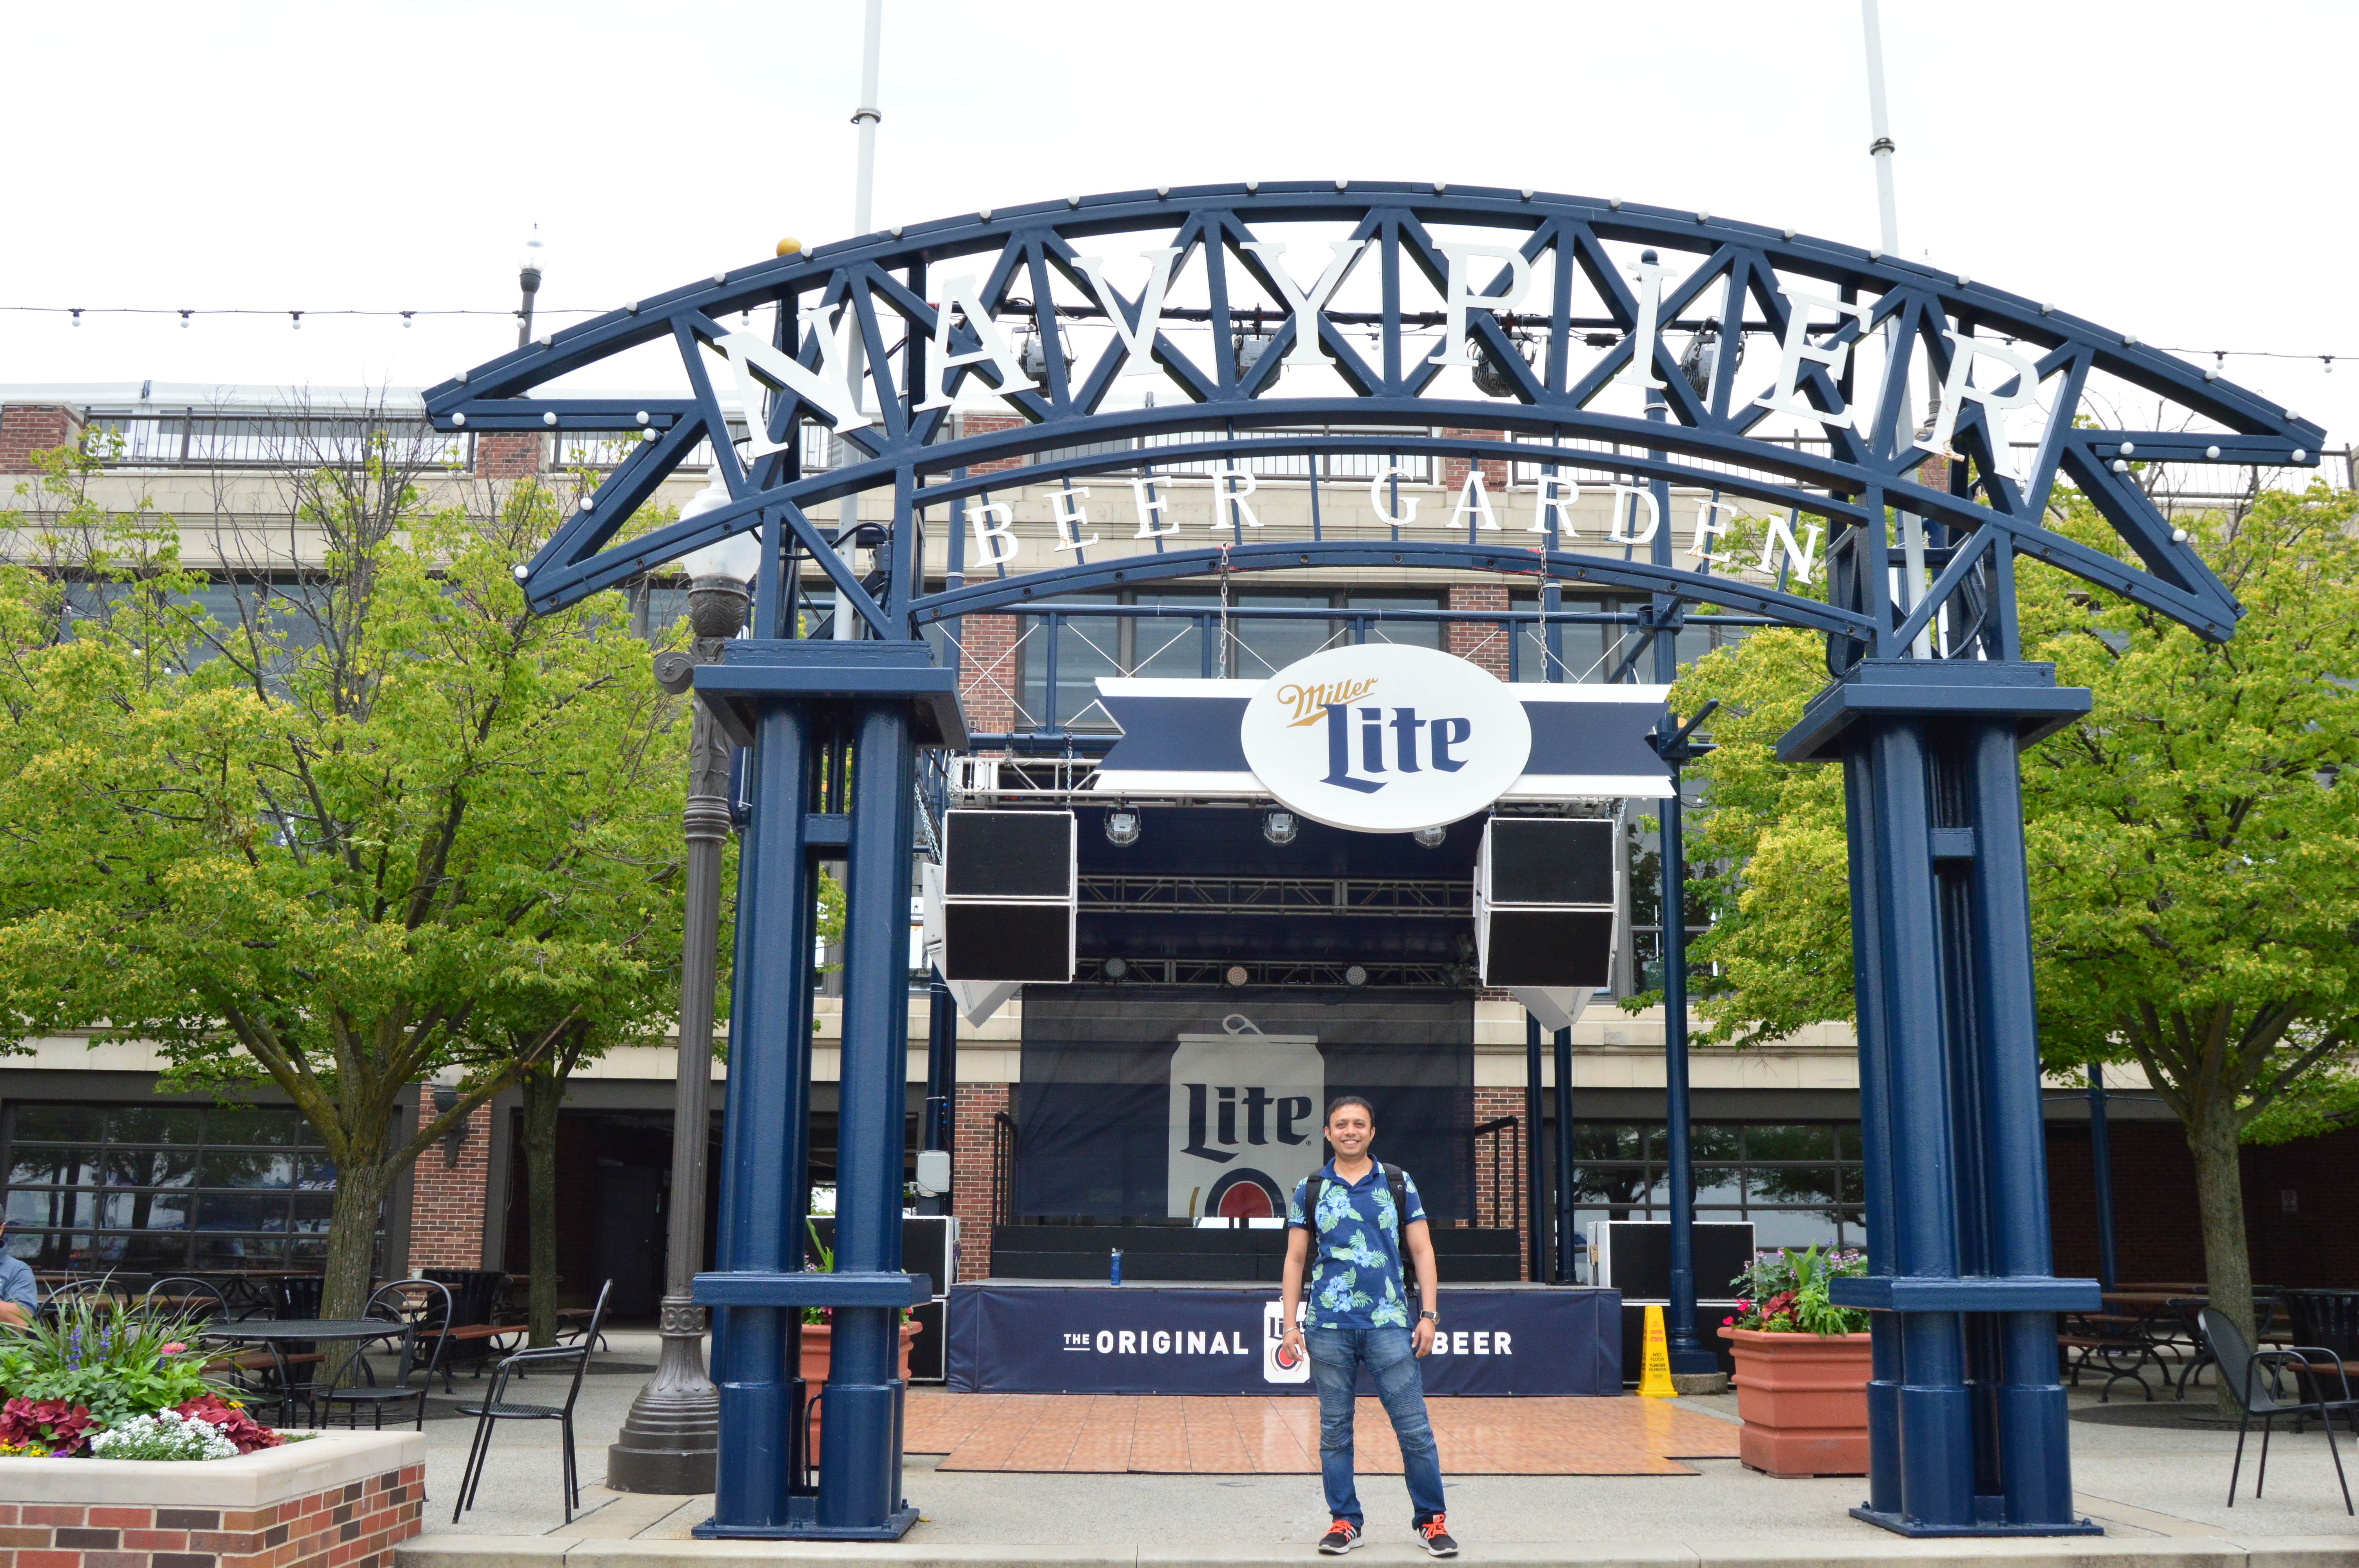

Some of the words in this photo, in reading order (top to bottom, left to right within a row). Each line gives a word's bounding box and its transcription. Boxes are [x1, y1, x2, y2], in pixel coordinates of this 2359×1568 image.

[713, 240, 1365, 459] NAVY
[1428, 240, 2041, 481] PIER
[963, 469, 1264, 568] BEER
[1371, 466, 1825, 585] GARDEN
[1277, 678, 1379, 720] Miller
[1318, 704, 1471, 794] Lite
[1180, 1083, 1312, 1163] Lite
[1064, 1334, 1090, 1344] THE
[1096, 1330, 1249, 1354] ORIGINAL
[1431, 1332, 1512, 1354] BEER
